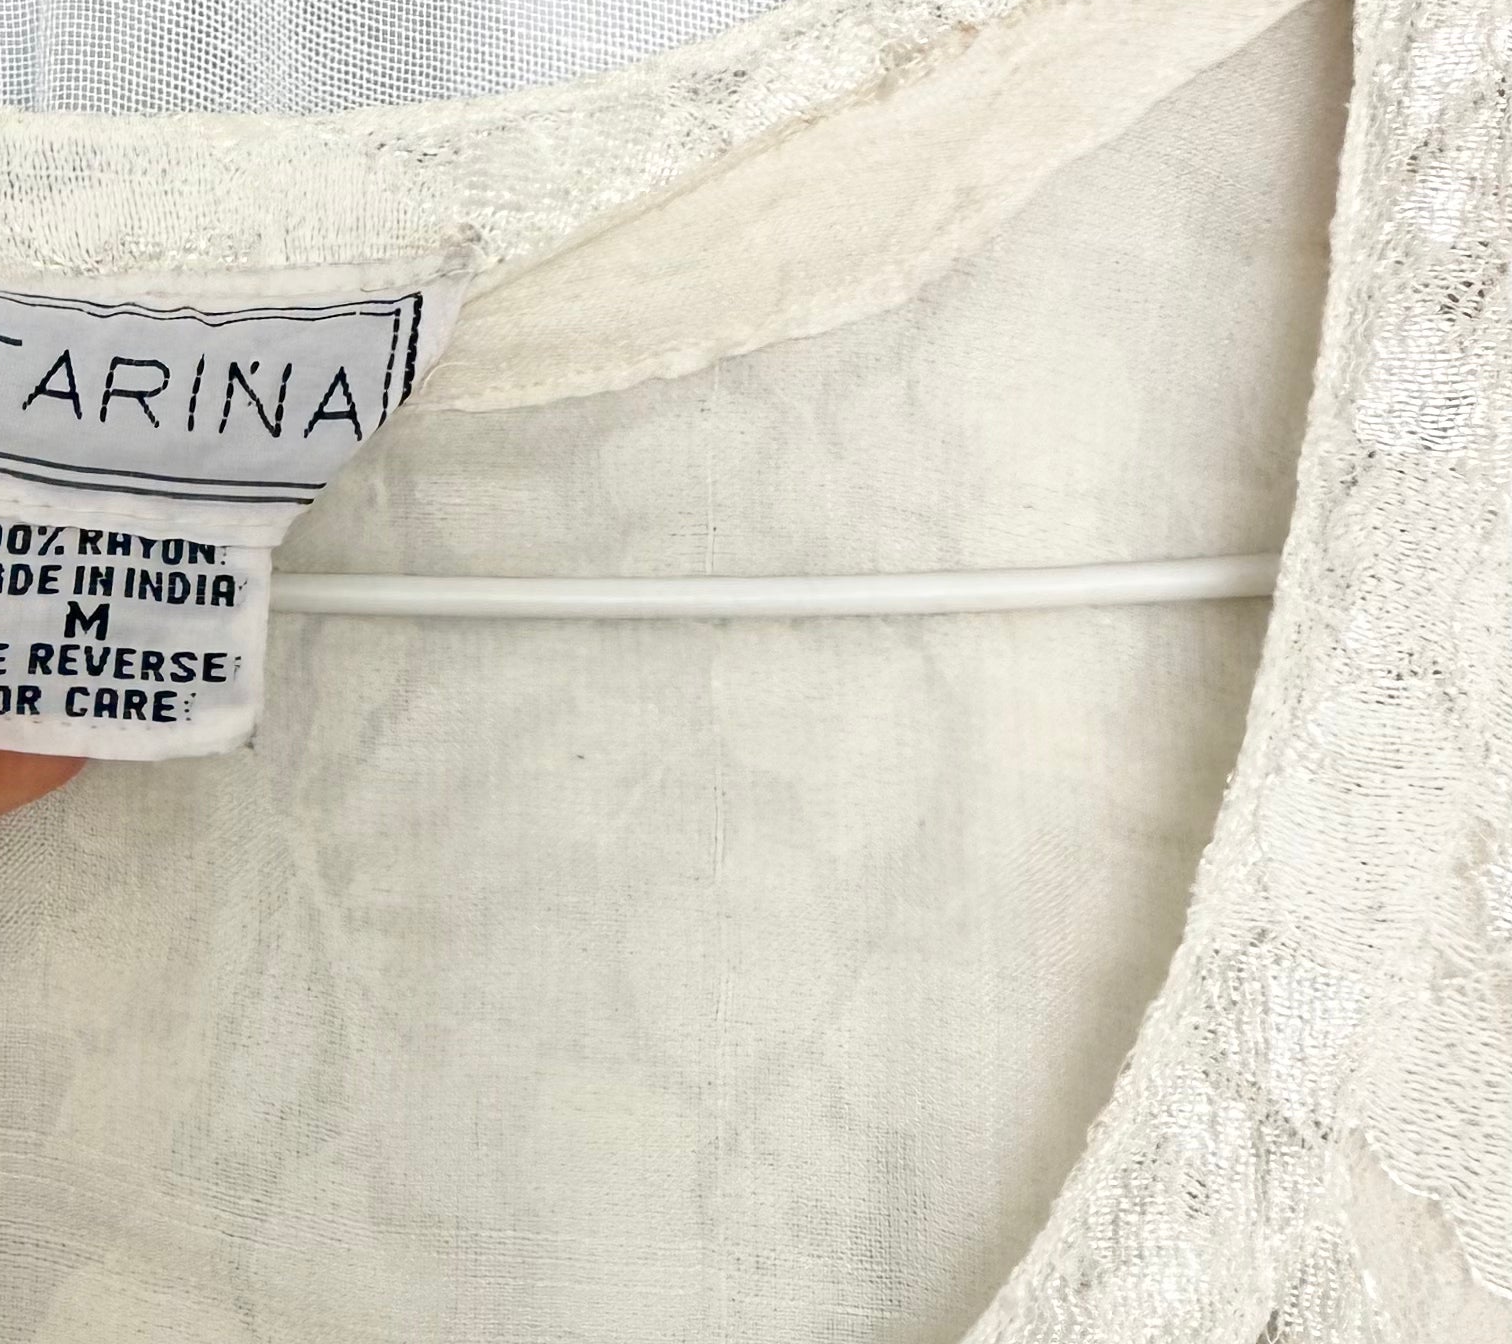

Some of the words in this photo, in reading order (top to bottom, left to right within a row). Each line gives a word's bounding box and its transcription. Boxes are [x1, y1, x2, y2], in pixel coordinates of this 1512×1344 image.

[79, 528, 217, 564] RAYON
[73, 565, 115, 598] IN
[124, 567, 237, 607] INDIA
[64, 601, 110, 641] M
[27, 645, 230, 683] REVERSE
[65, 687, 178, 723] CARE
